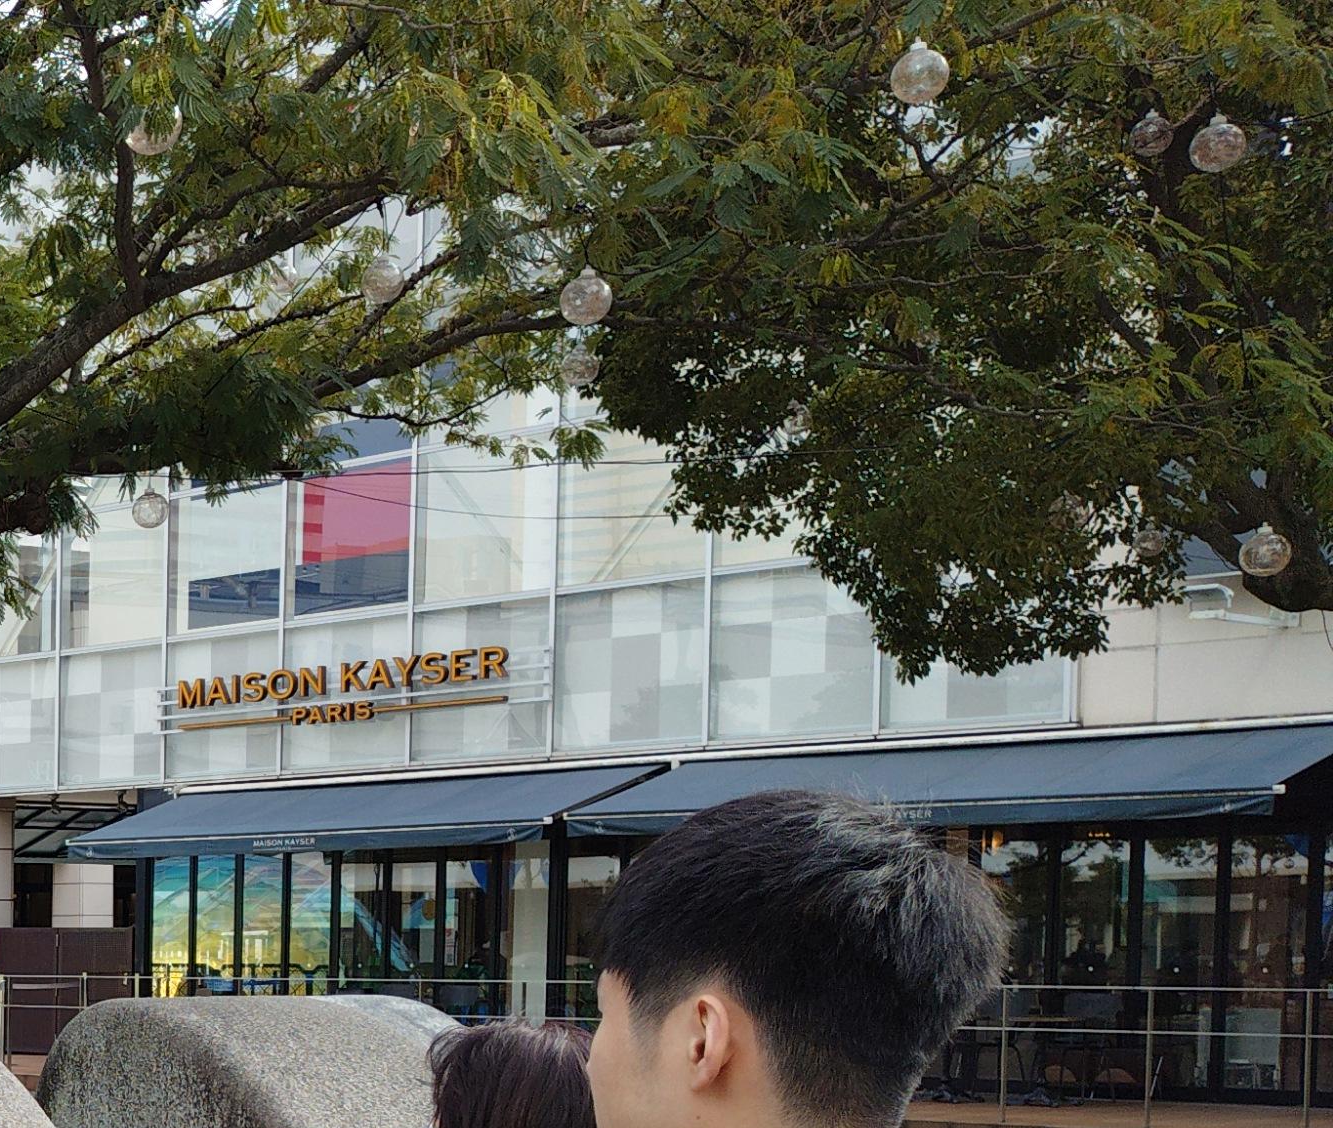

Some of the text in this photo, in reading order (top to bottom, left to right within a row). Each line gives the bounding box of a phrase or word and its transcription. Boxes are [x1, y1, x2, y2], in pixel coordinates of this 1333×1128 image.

[177, 645, 509, 709] MAISON KAYSER
[291, 701, 375, 726] PARIS
[253, 839, 283, 847] MAISON
